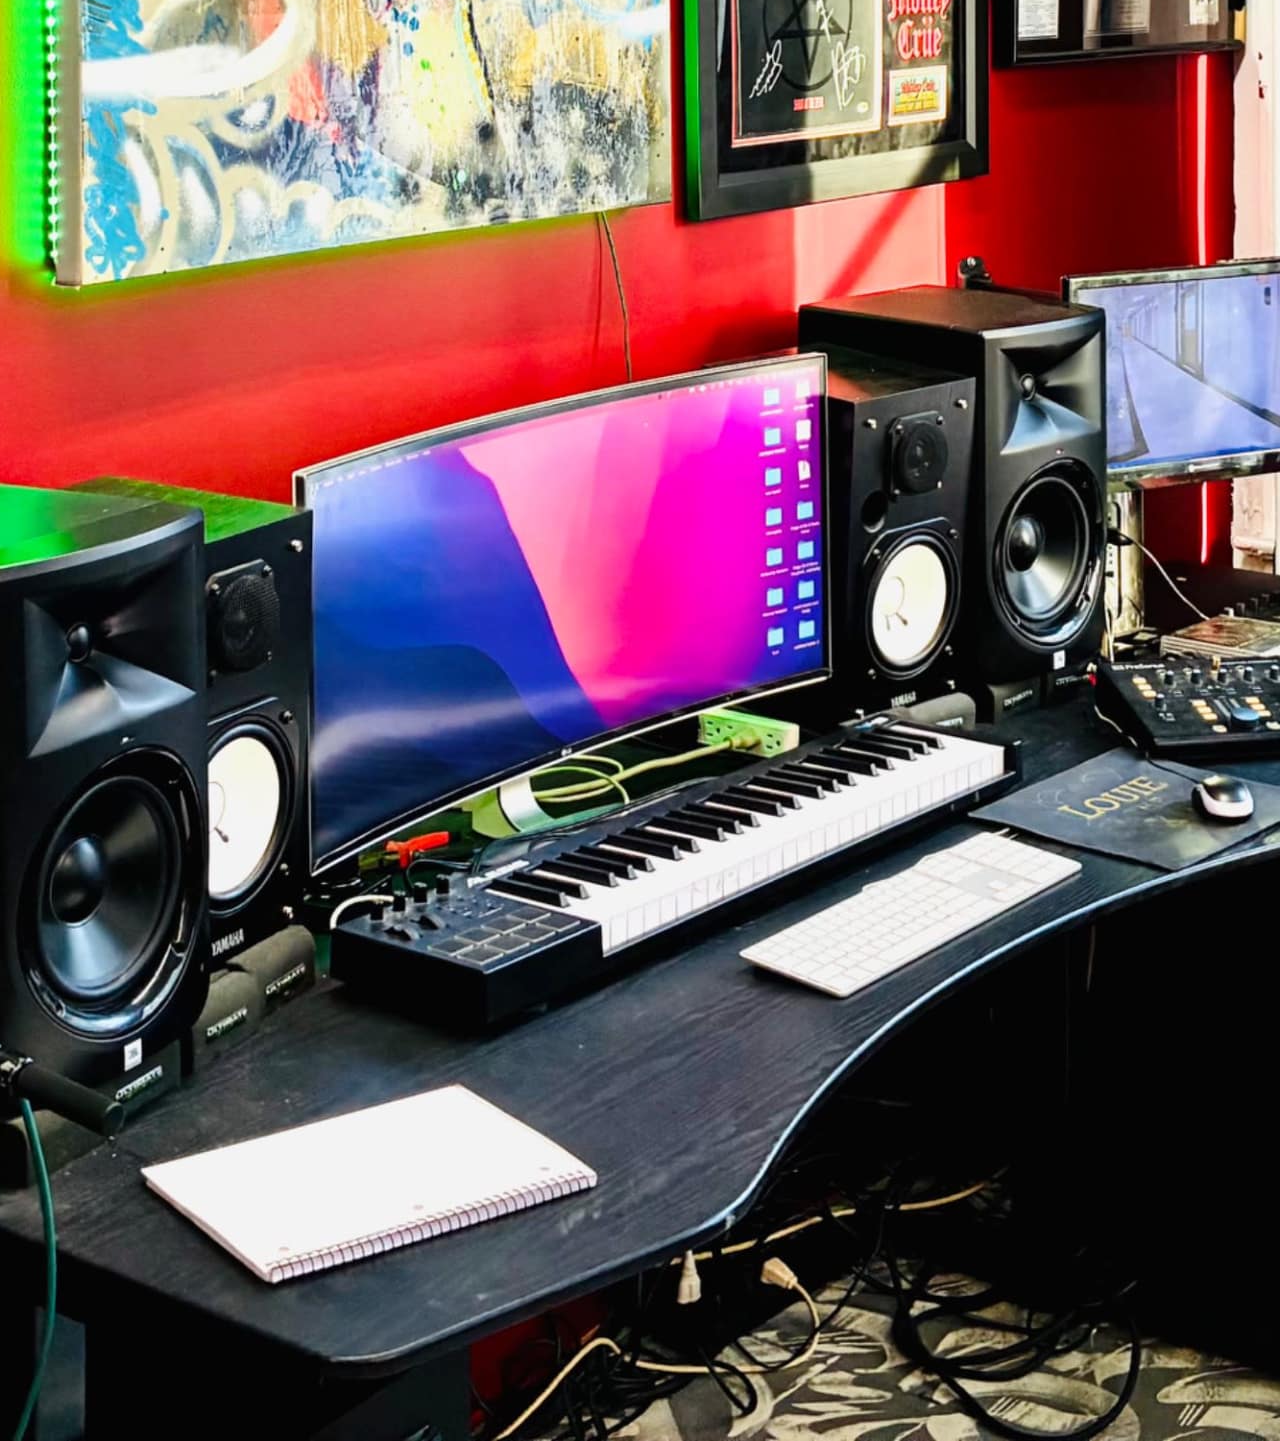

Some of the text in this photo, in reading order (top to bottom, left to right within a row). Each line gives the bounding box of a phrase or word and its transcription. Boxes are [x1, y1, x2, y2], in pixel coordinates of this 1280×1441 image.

[895, 21, 944, 63] Crüe
[891, 691, 917, 708] YAMAHA
[1058, 775, 1168, 820] LOUIE
[211, 928, 244, 957] YAMAHA
